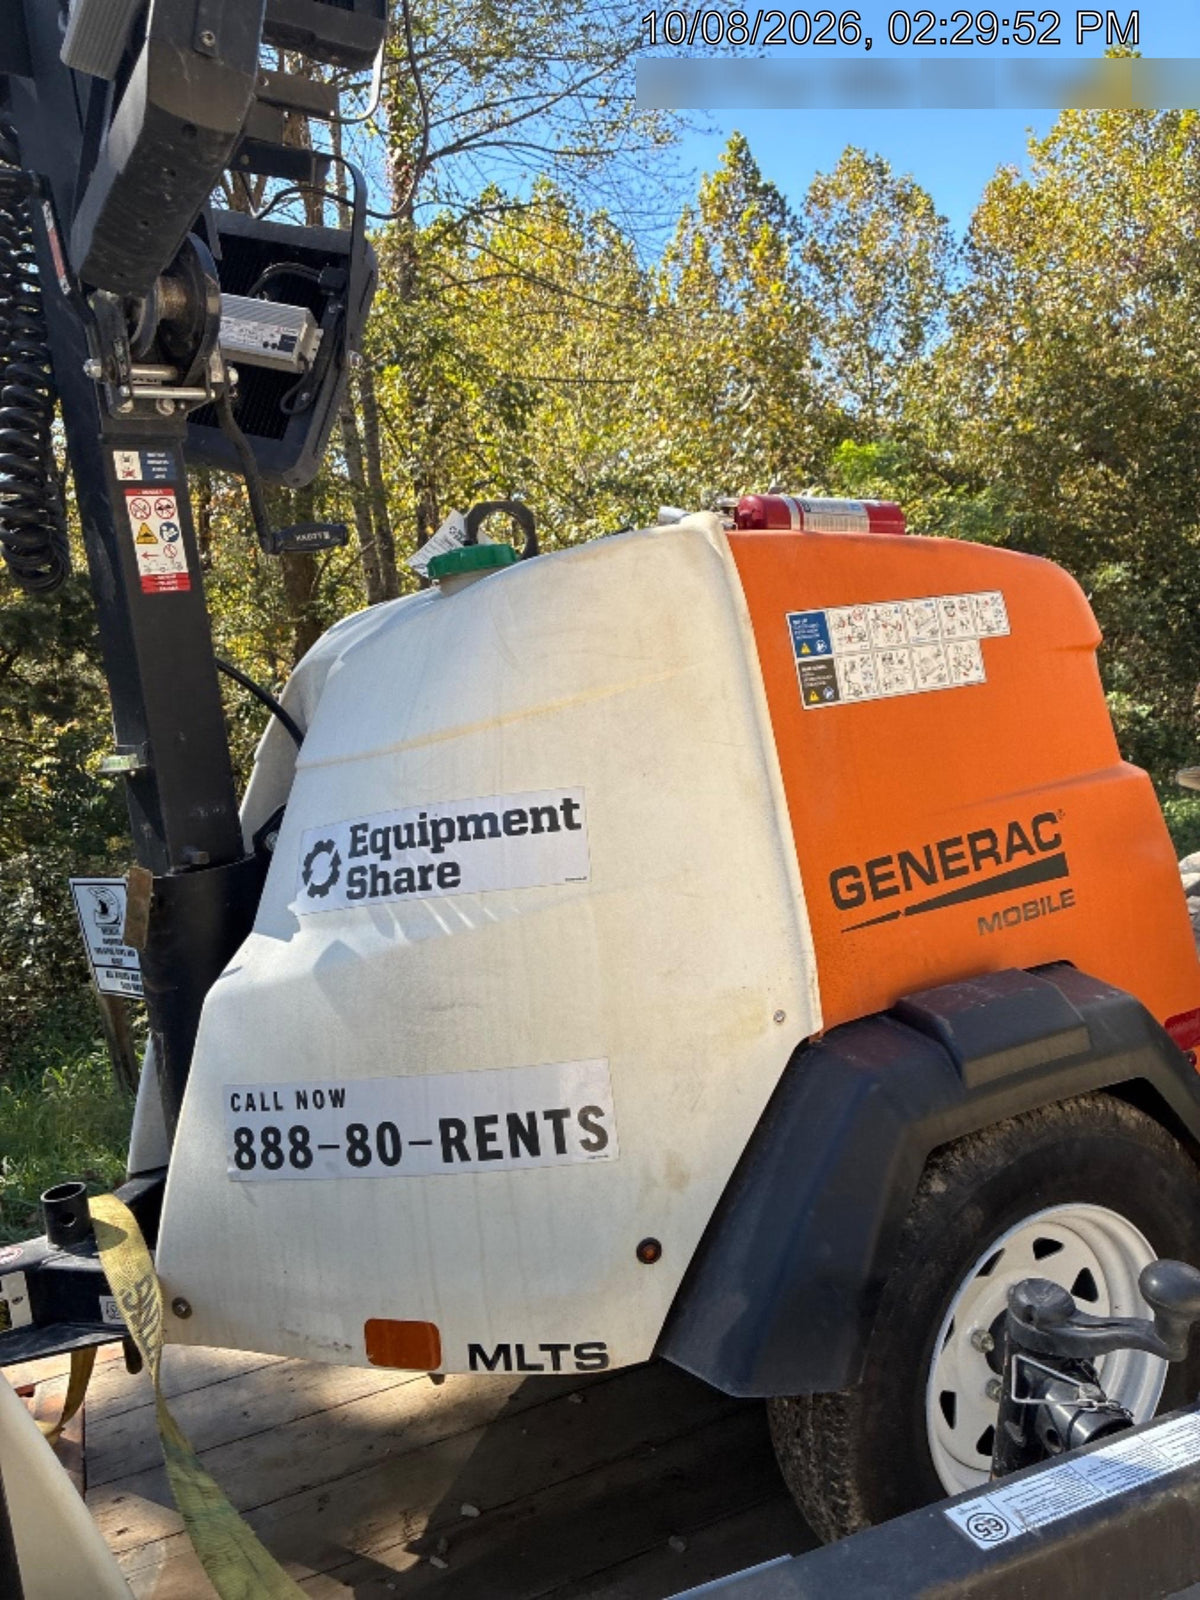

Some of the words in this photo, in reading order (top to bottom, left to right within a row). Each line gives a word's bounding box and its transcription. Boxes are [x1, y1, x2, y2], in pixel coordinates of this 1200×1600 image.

[348, 797, 582, 861] Equipment
[346, 861, 461, 900] Share
[828, 811, 1063, 911] GENERAC
[977, 888, 1076, 935] MOBILE
[230, 1091, 284, 1113] CALL
[296, 1087, 346, 1111] NOW
[233, 1104, 610, 1171] 888-80-RENTS
[467, 1341, 610, 1371] MLTS
